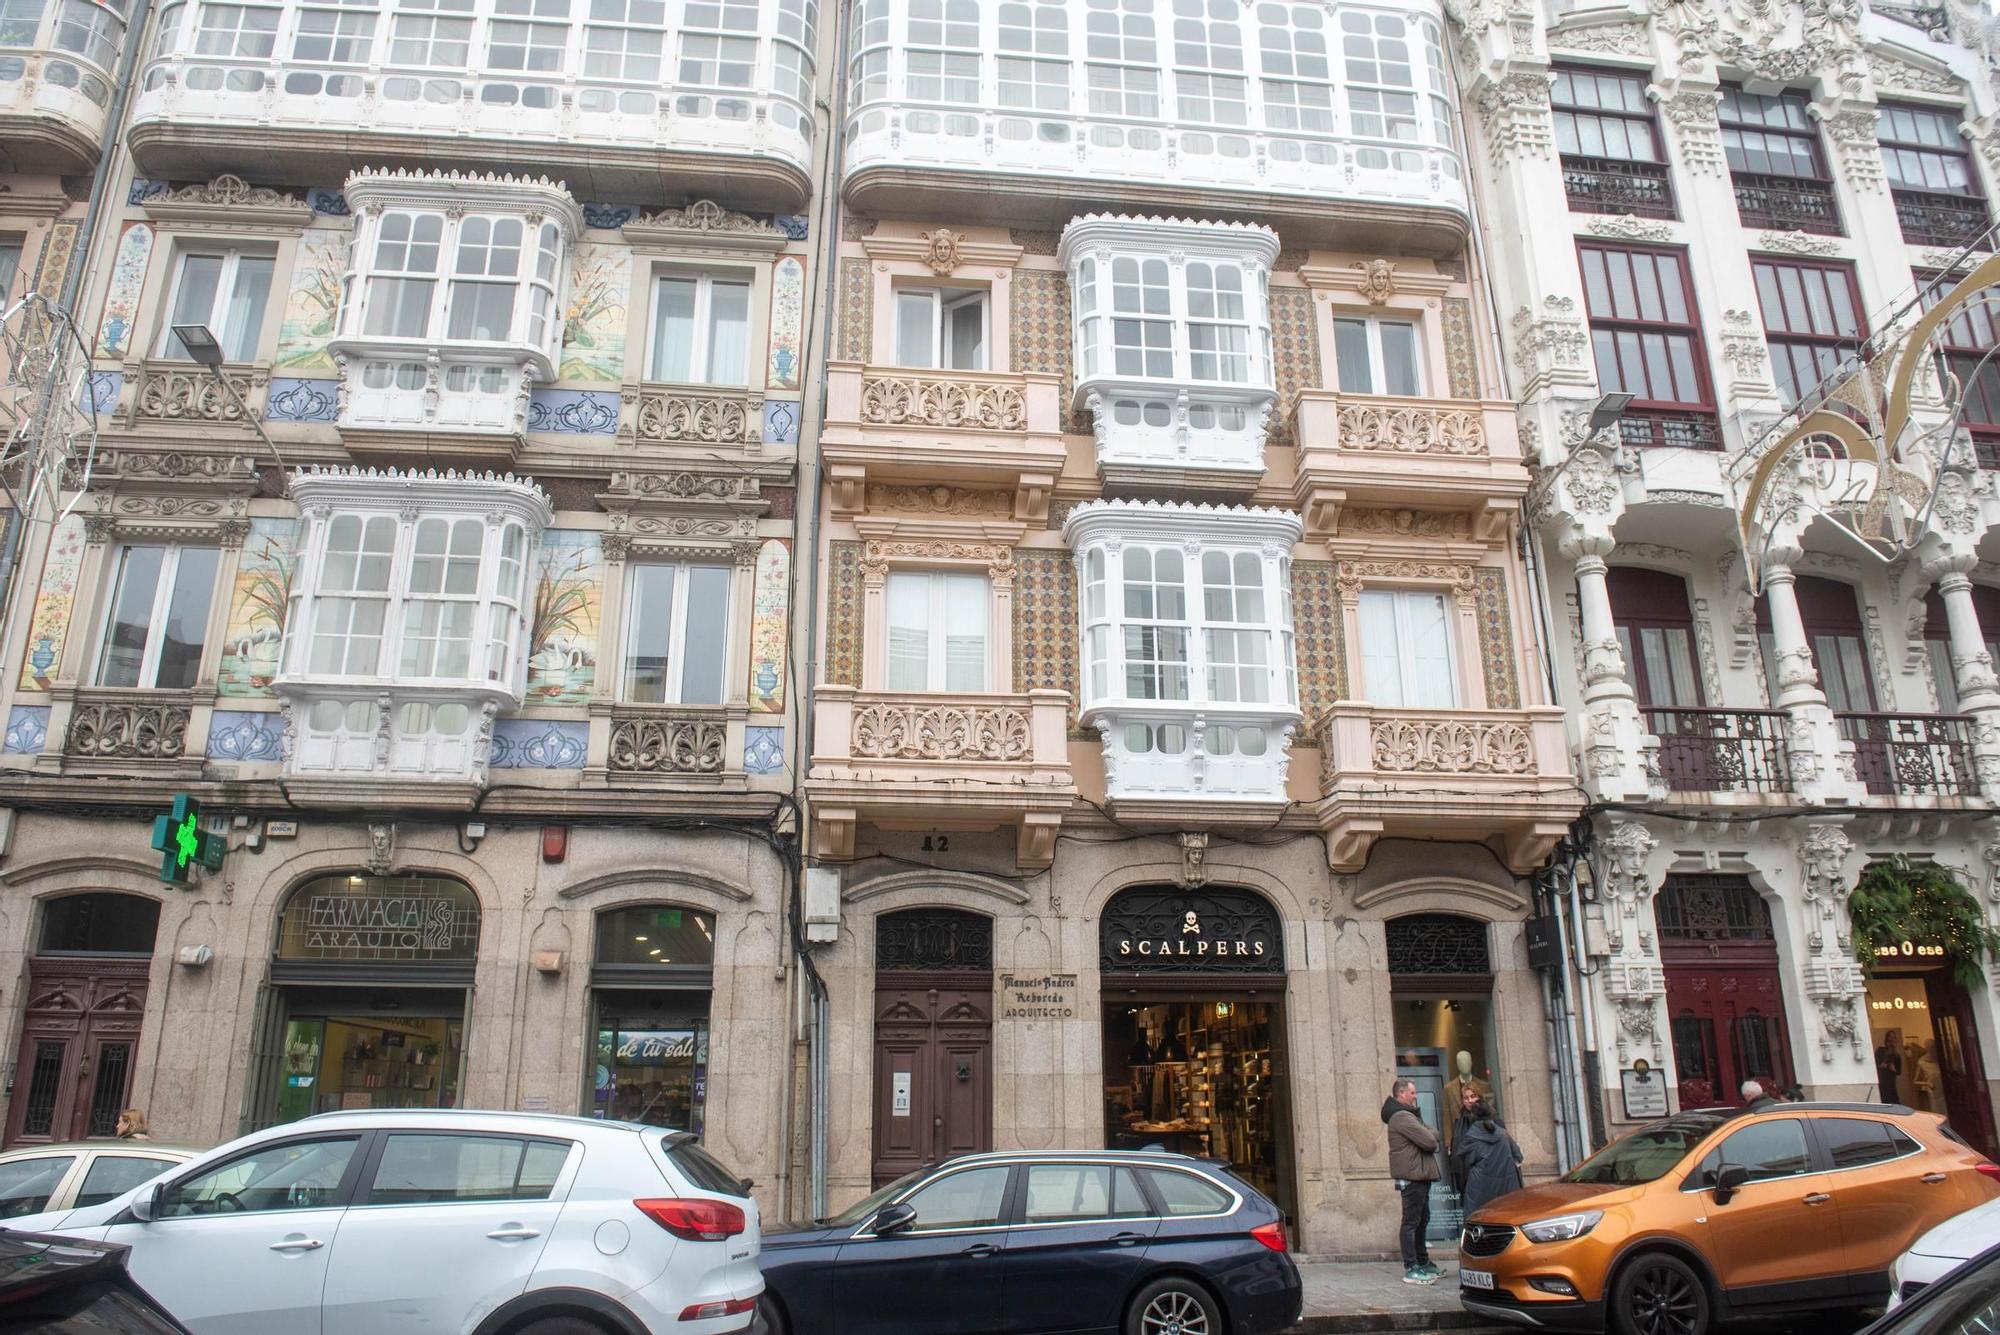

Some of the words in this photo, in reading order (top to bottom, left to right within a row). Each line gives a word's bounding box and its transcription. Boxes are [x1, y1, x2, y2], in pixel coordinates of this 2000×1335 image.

[921, 835, 949, 852] 12
[312, 898, 421, 928] FARMACIA
[308, 931, 420, 948] ARAUJO
[1120, 940, 1264, 955] SCALPERS
[1917, 945, 1944, 956] ese
[1006, 1008, 1073, 1018] ARQUITECTO
[642, 1038, 663, 1058] tu
[1431, 1184, 1451, 1193] From
